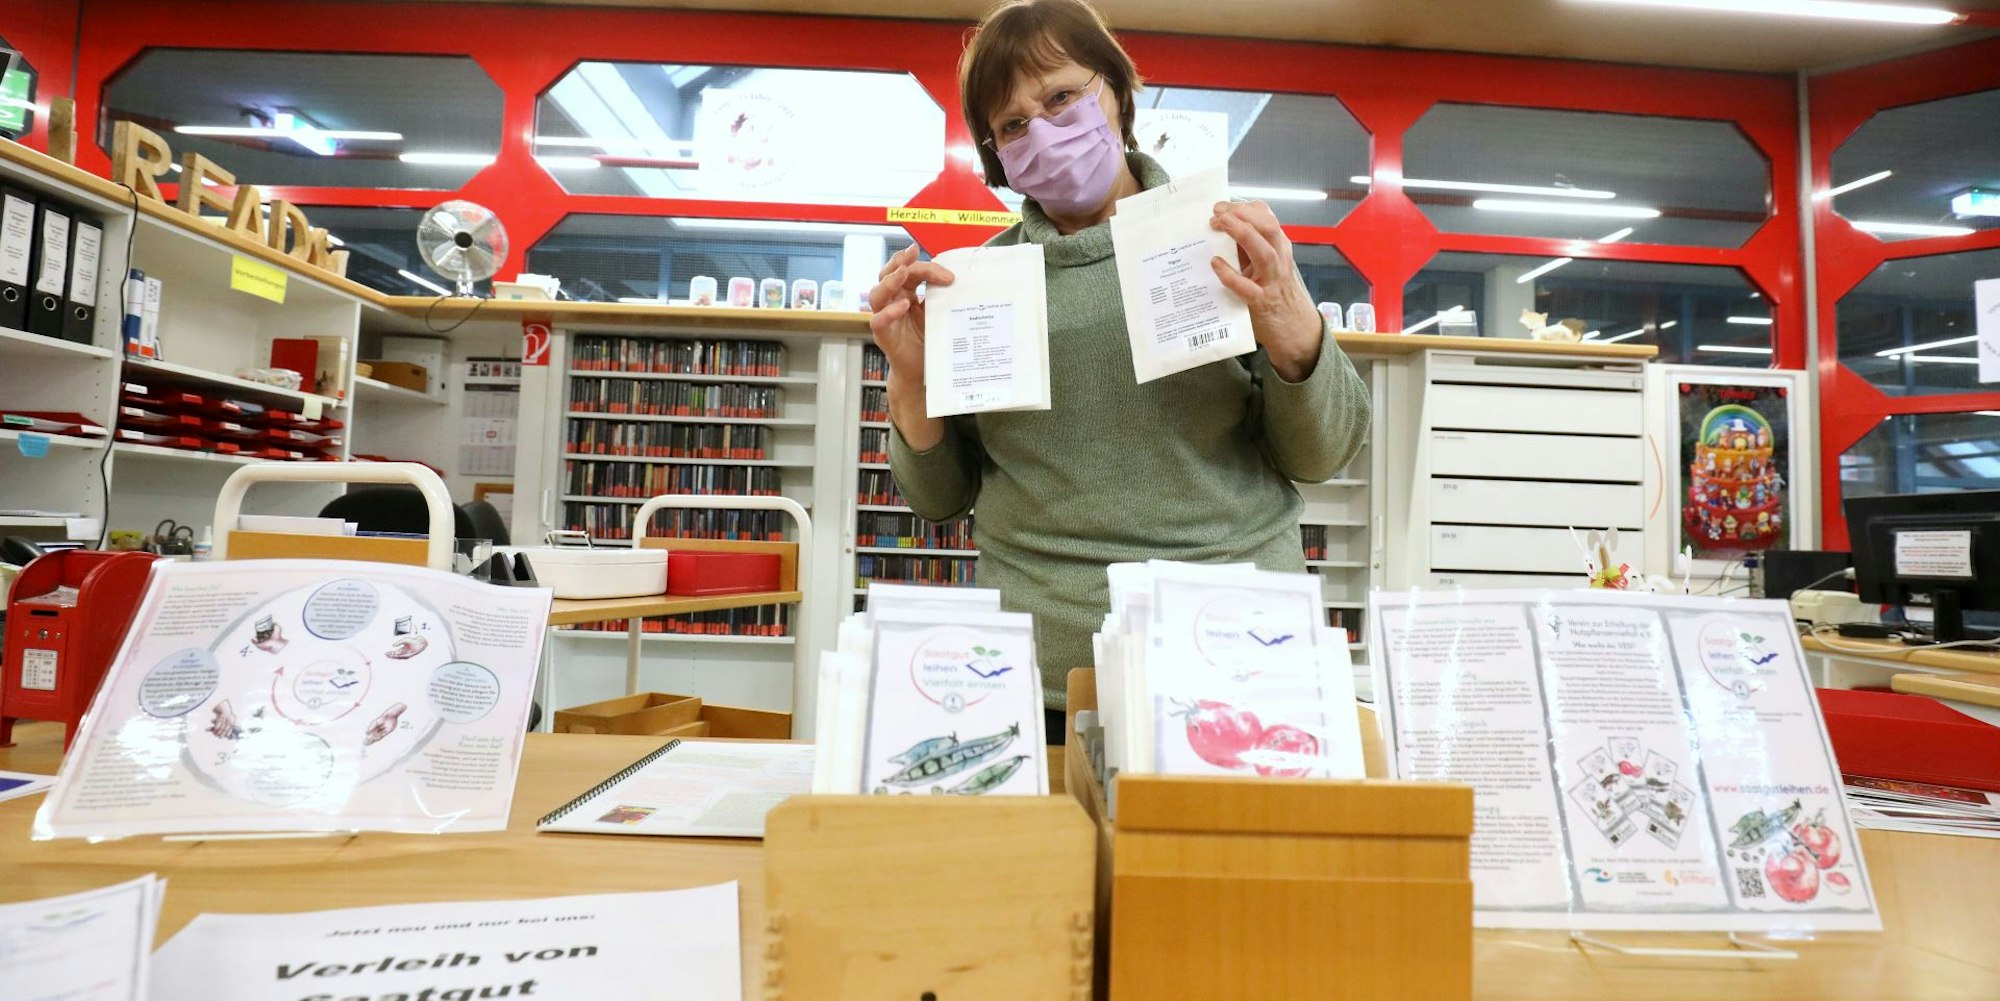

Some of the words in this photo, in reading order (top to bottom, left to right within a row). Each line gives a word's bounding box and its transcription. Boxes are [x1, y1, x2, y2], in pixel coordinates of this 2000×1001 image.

[890, 209, 936, 221] Herzlich
[958, 212, 1022, 224] Willkommen
[1567, 619, 1589, 628] Verein
[1605, 619, 1637, 630] Erhaltung
[1206, 629, 1240, 639] leihen
[924, 648, 970, 660] Saatgut
[1708, 650, 1735, 660] leihen
[923, 663, 957, 672] leihen
[922, 678, 964, 688] Vielfalt
[967, 680, 1007, 690] ernten
[1713, 784, 1829, 796] www.saatgutleihen.de
[326, 928, 381, 938] Jetzt
[433, 922, 471, 931] und
[276, 952, 481, 980] Verleih
[504, 946, 599, 964] von
